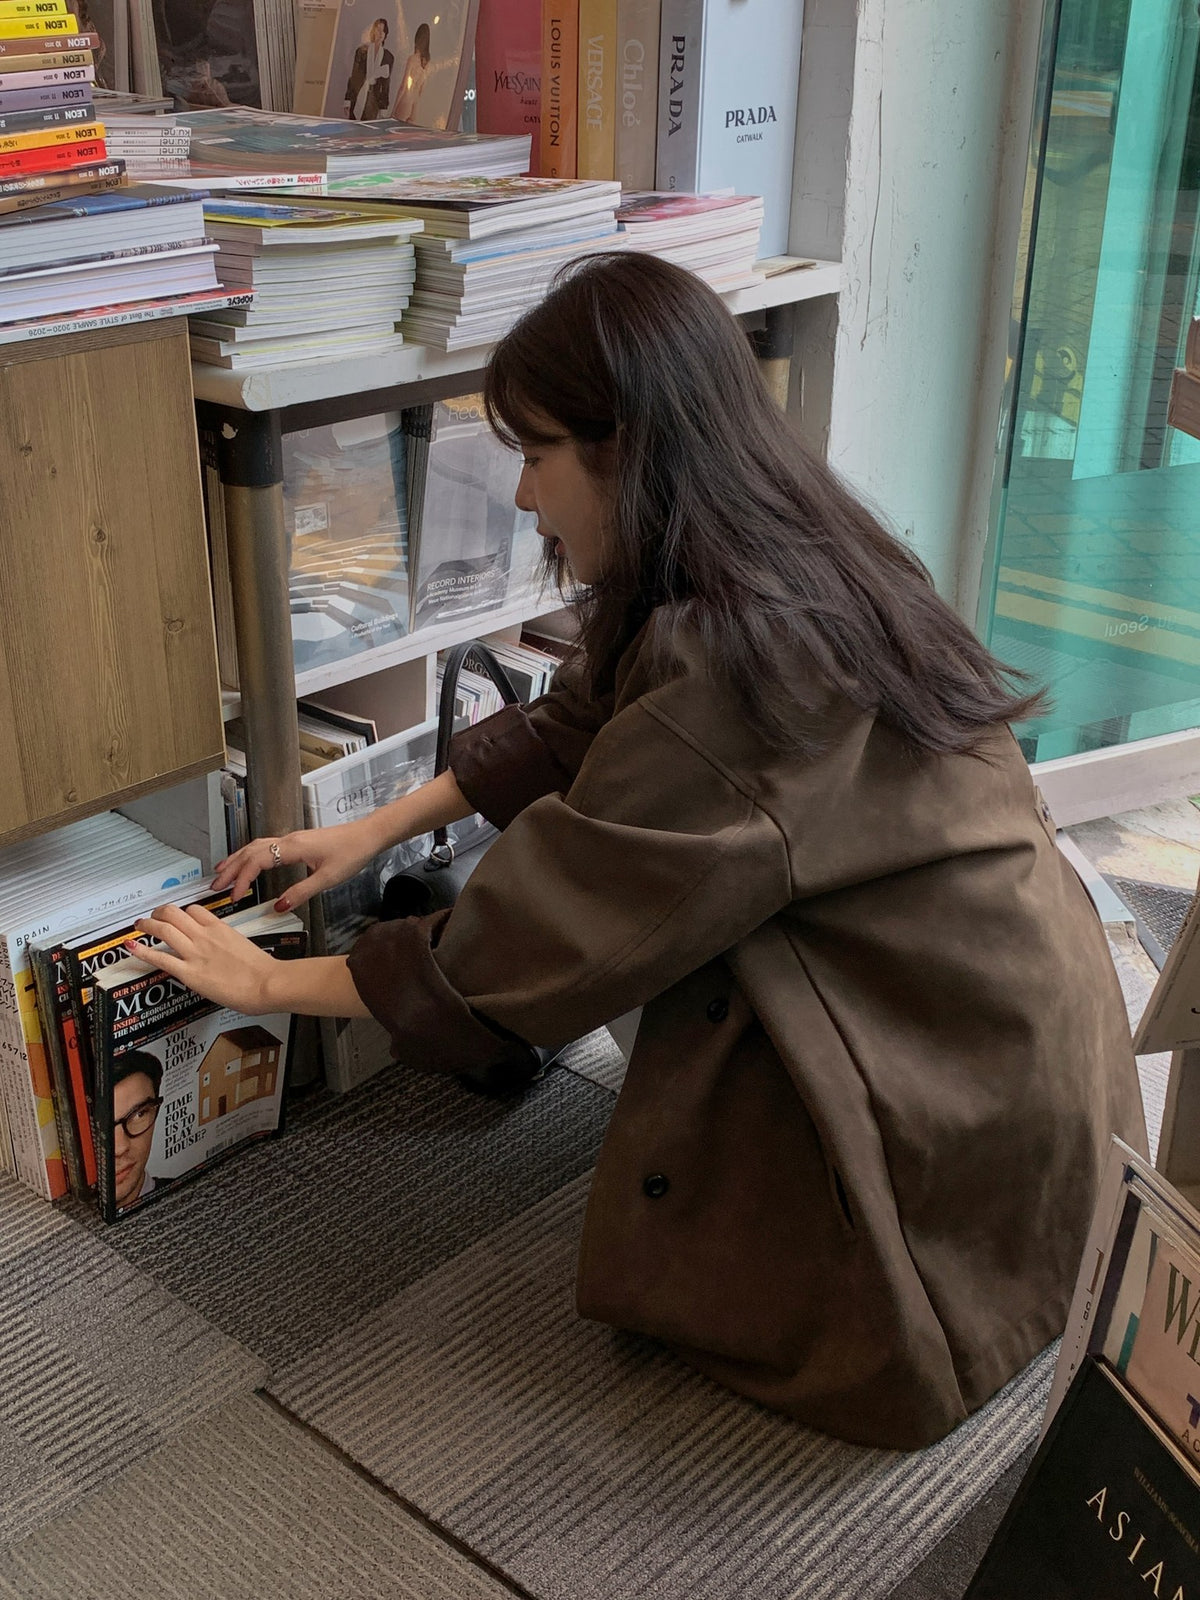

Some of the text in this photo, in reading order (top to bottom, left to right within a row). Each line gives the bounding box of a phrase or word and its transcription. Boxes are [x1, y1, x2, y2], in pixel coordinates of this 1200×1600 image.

[36, 3, 58, 12] LEON
[45, 20, 68, 30] LEON
[67, 37, 91, 47] LEON
[62, 54, 85, 64] LEON
[64, 70, 86, 80] LEON
[550, 20, 561, 146] LOUIS VUITTON
[586, 35, 604, 130] VERSACE
[622, 39, 644, 128] Chloé
[668, 36, 686, 138] PRADA
[62, 89, 84, 99] LEON
[65, 109, 87, 120] LEON
[524, 116, 541, 124] CAT
[726, 106, 777, 128] PRADA
[75, 128, 97, 138] LEON
[736, 132, 763, 143] CATWALK
[77, 147, 98, 157] LEON
[98, 166, 119, 176] LEON
[105, 178, 122, 188] LEON
[227, 295, 254, 306] POPEYE
[121, 314, 127, 322] of
[129, 311, 143, 321] Best
[144, 308, 155, 317] The
[75, 318, 98, 330] SAMPLE
[100, 315, 118, 325] STYLE
[427, 570, 495, 592] RECORD INTERIORS
[16, 925, 50, 947] BRAIN
[113, 987, 129, 999] OUR
[130, 980, 148, 993] NEW
[113, 1014, 139, 1031] INSIDE:
[140, 1002, 171, 1019] GEORGIA
[172, 992, 188, 1005] DOES
[113, 1028, 128, 1039] THE
[129, 1020, 147, 1033] NEW
[147, 1003, 183, 1025] PROPERTY
[165, 1028, 189, 1047] YOU
[165, 1035, 197, 1060] LOOK
[165, 1041, 207, 1071] LOVELY
[165, 1092, 193, 1115] TIME
[165, 1107, 188, 1126] FOR
[165, 1113, 195, 1137] US TO
[165, 1125, 193, 1149] PLAY
[165, 1129, 207, 1160] HOUSE?
